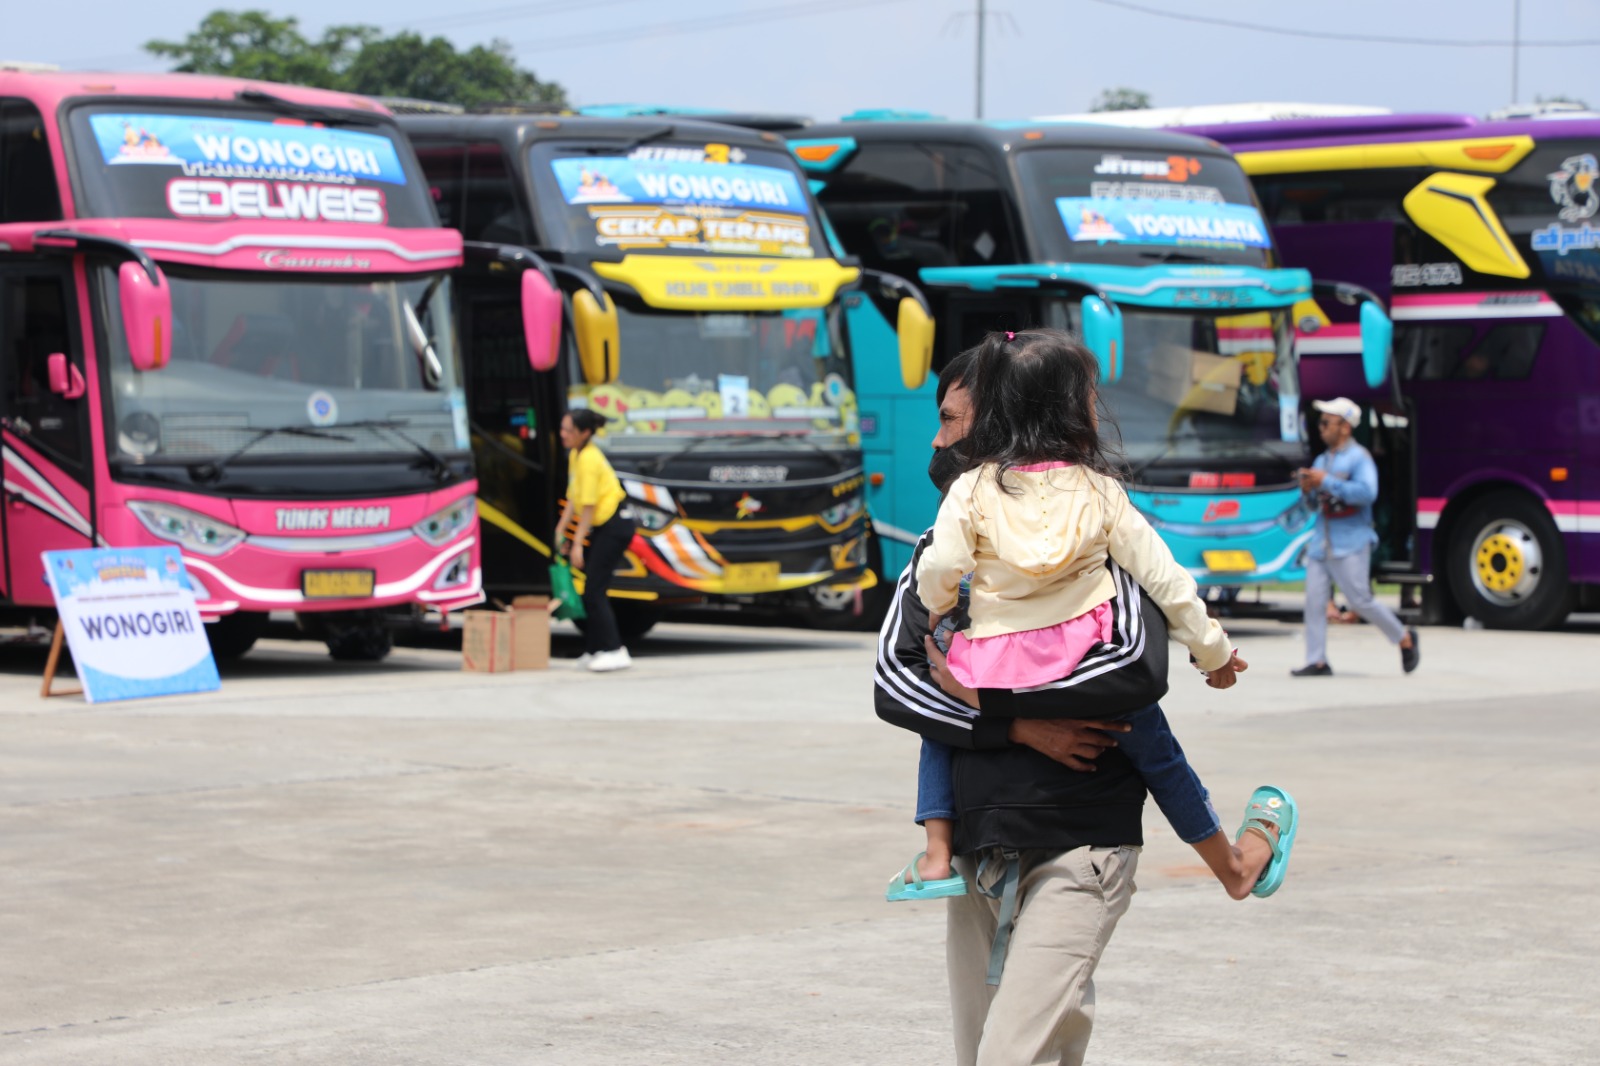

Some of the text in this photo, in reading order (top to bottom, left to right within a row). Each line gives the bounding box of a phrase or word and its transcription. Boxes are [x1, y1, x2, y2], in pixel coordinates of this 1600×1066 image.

[193, 133, 381, 177] WONOGIRI
[167, 179, 386, 225] EDELWEIS
[636, 173, 790, 207] WONOGIRI
[598, 216, 808, 245] CEKAP TERANG
[1126, 213, 1264, 243] YOGYAKARTA
[275, 506, 391, 531] TUNAS MERAPI
[79, 609, 195, 642] WONOGIRI
